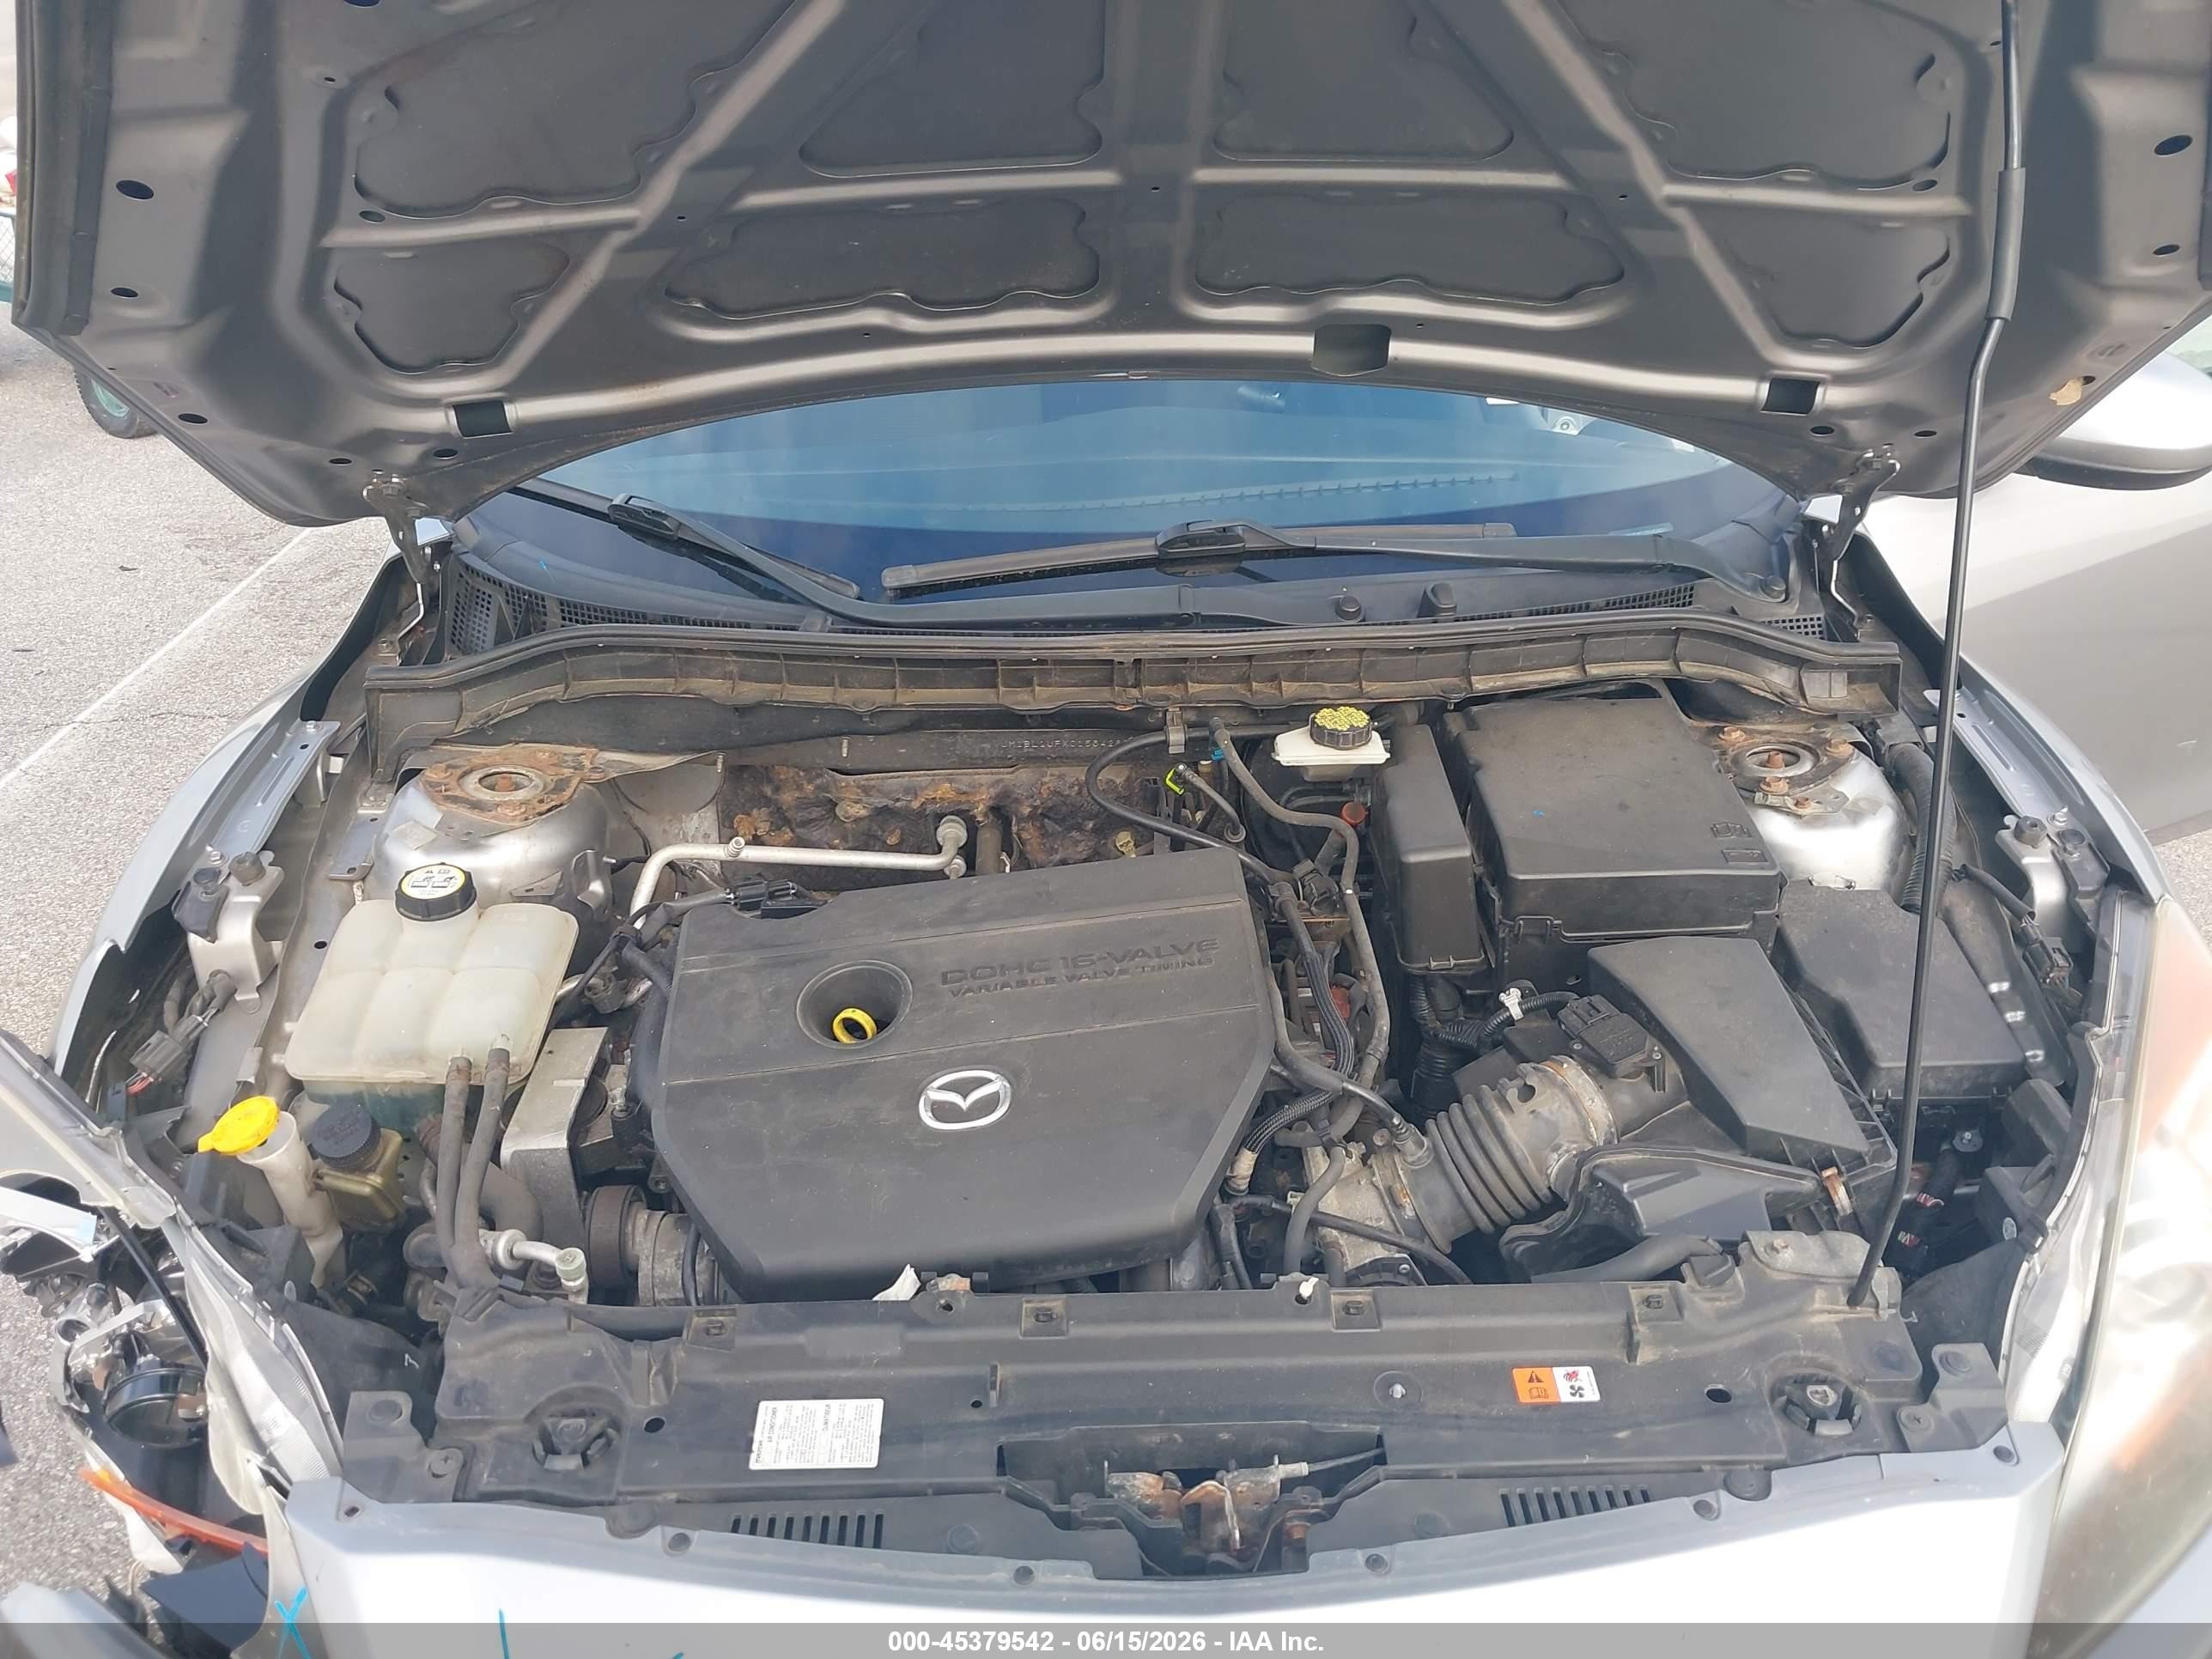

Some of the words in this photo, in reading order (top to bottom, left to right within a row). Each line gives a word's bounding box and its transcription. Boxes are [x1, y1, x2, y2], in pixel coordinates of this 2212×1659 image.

[941, 957, 1053, 986] DOHC
[1059, 938, 1221, 969] 16-VALVE
[949, 975, 1057, 999] VARIABLE
[1063, 967, 1132, 984] VALVE
[1141, 957, 1216, 975] TIMING
